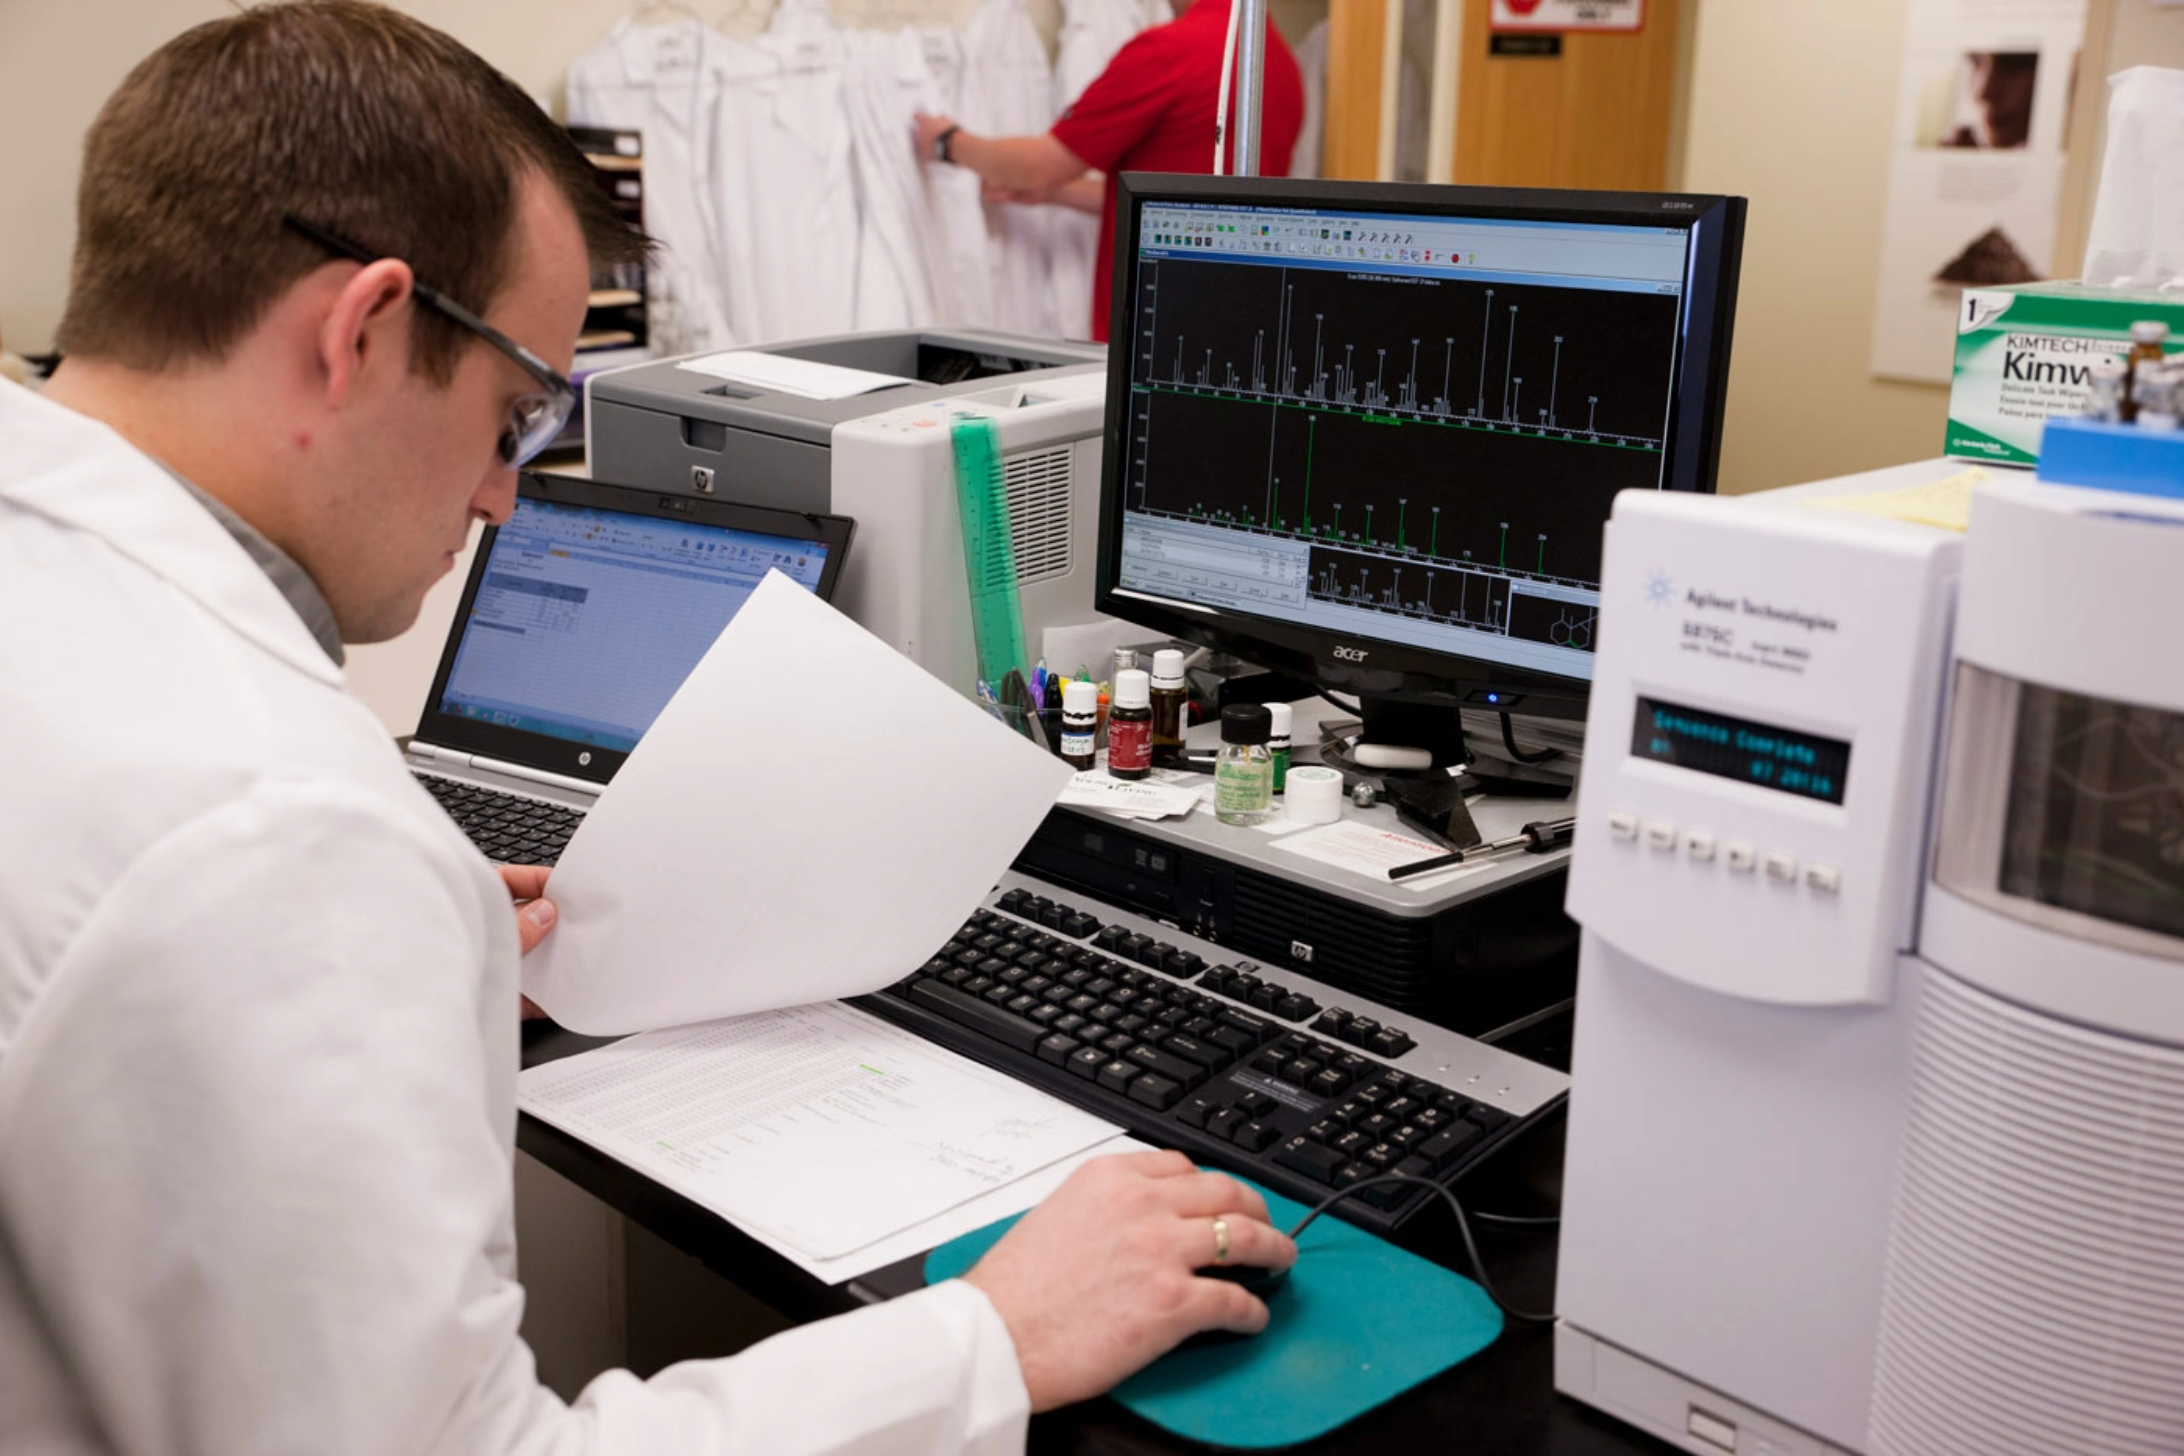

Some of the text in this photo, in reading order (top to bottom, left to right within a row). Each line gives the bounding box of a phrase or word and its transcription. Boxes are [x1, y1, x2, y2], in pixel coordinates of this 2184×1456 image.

[1968, 298, 1976, 322] 1
[2007, 334, 2089, 353] KIMTECH
[1686, 588, 1838, 632] Agilent Technologies
[1333, 645, 1369, 662] acer
